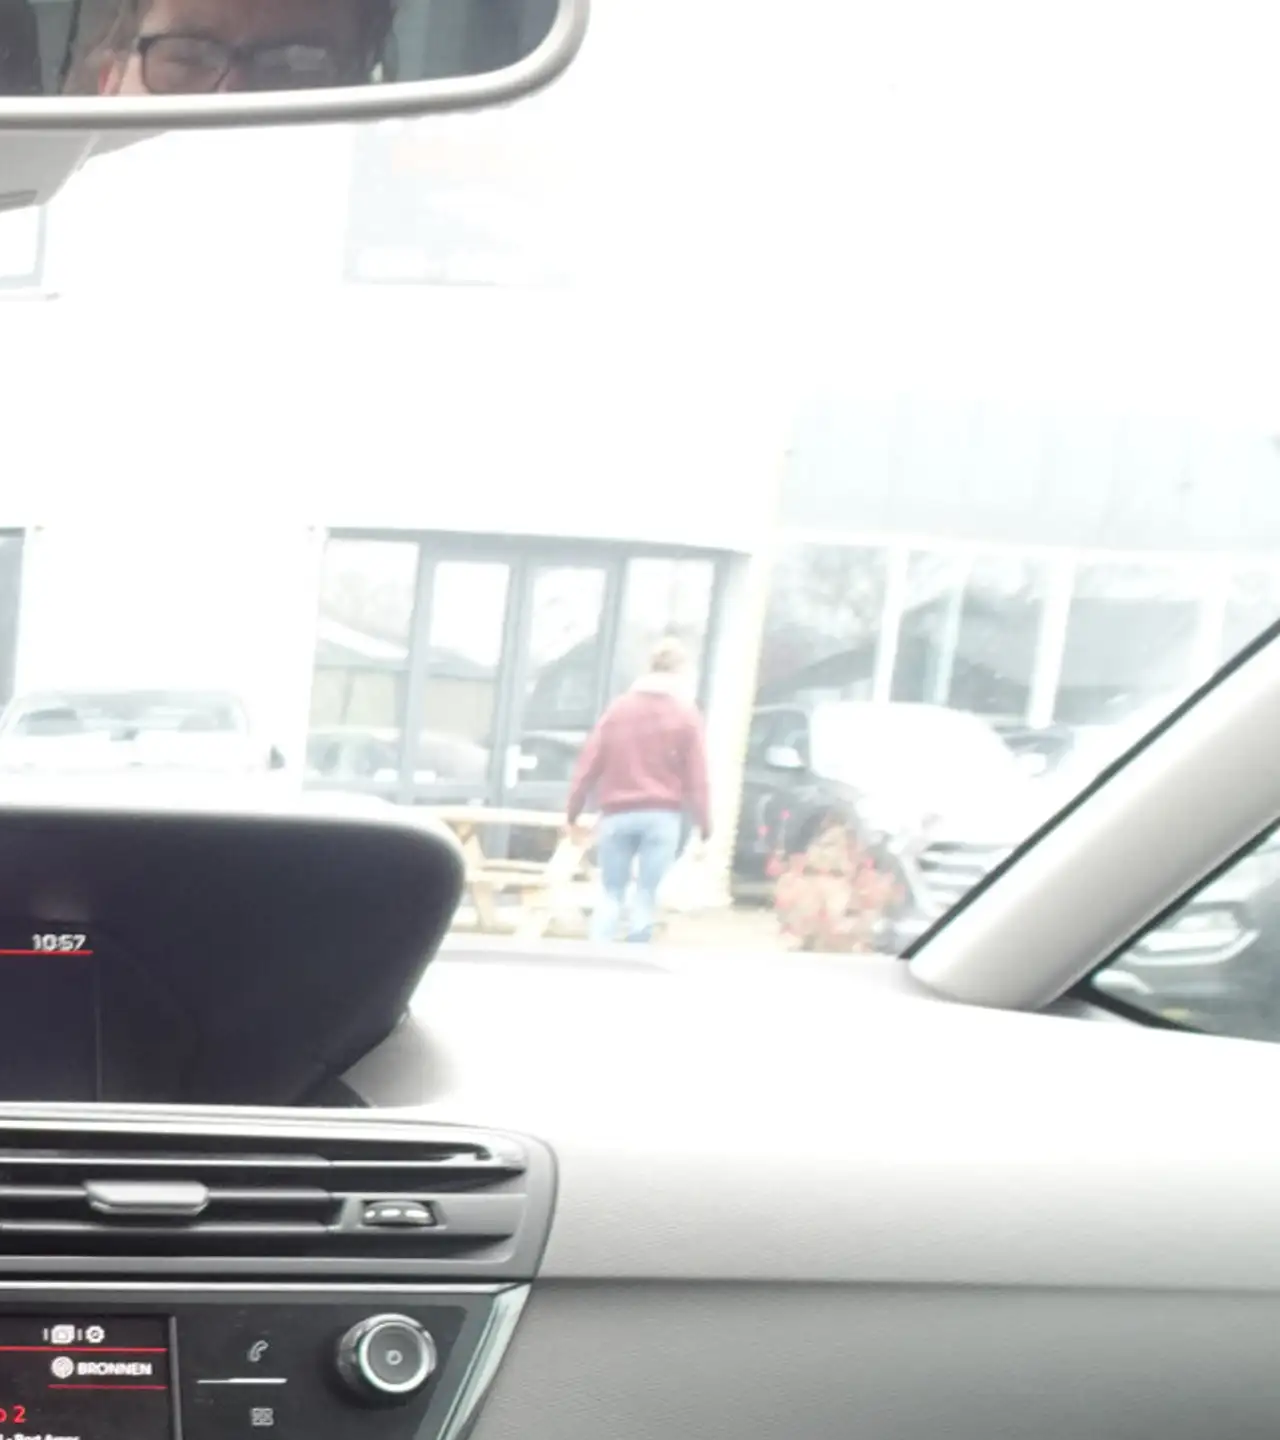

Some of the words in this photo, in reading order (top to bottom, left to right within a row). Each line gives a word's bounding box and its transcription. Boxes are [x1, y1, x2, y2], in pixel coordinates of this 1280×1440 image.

[32, 933, 87, 951] 10:57
[77, 1361, 153, 1376] BRONNEN
[13, 1405, 26, 1424] 2
